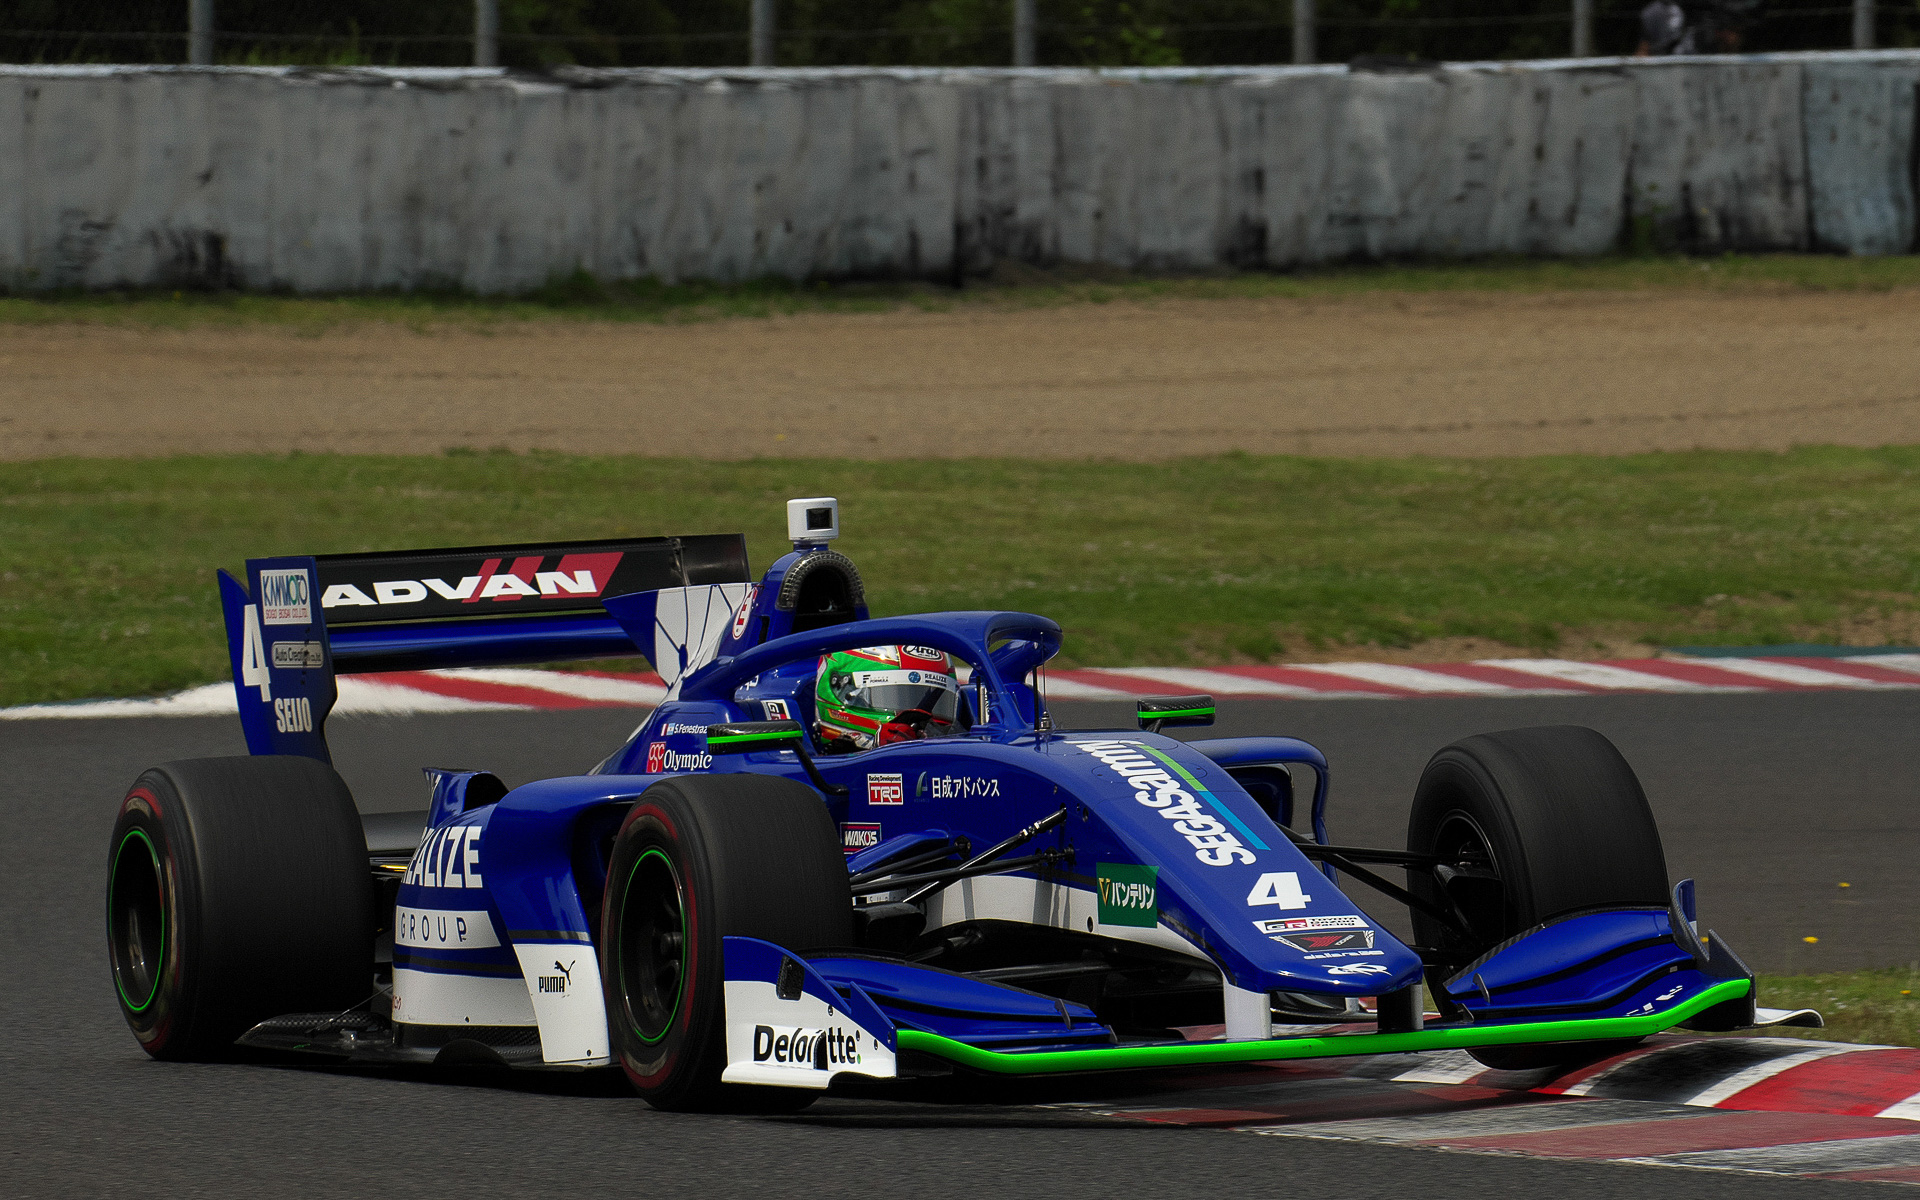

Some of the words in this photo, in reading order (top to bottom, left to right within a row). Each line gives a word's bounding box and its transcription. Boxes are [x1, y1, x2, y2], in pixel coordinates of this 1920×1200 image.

[322, 570, 598, 608] ADVAN
[242, 604, 271, 702] 4
[663, 749, 713, 771] Olympic
[870, 785, 901, 803] TRD
[932, 774, 1000, 799] 日成アドバンス
[1111, 881, 1155, 910] バンテリン
[1246, 871, 1312, 911] 4
[401, 911, 468, 943] GROUP
[538, 975, 566, 993] PUMA
